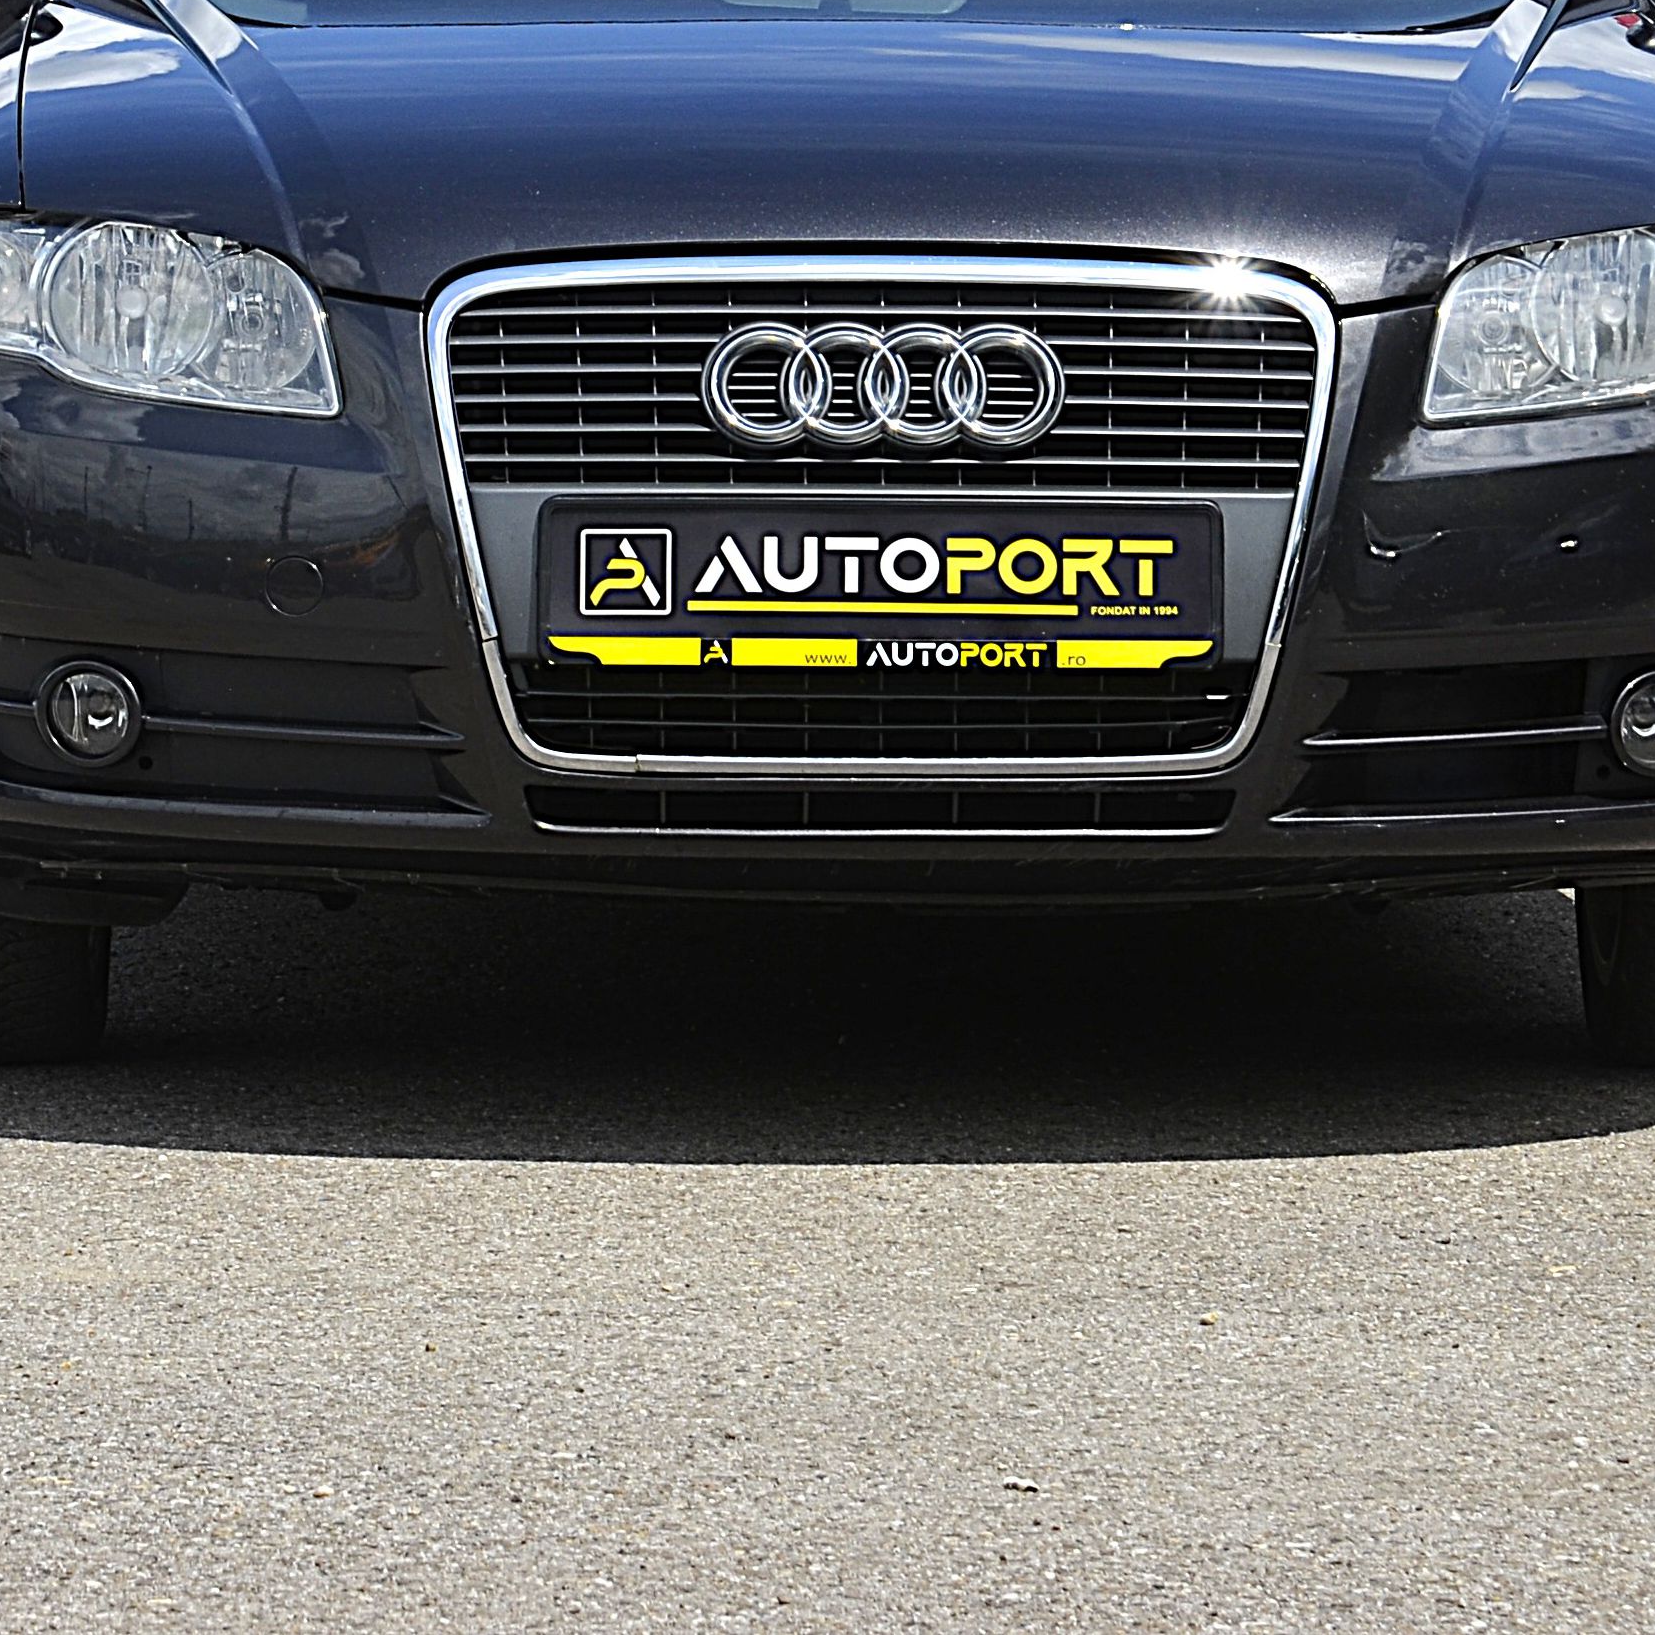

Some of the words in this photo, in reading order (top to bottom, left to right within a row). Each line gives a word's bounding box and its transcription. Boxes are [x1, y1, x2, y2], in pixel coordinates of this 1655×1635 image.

[694, 535, 1174, 596] AUTOPORT
[1090, 605, 1137, 616] FONDAT
[1139, 605, 1151, 616] IN
[866, 640, 1048, 668] AUTOPORT
